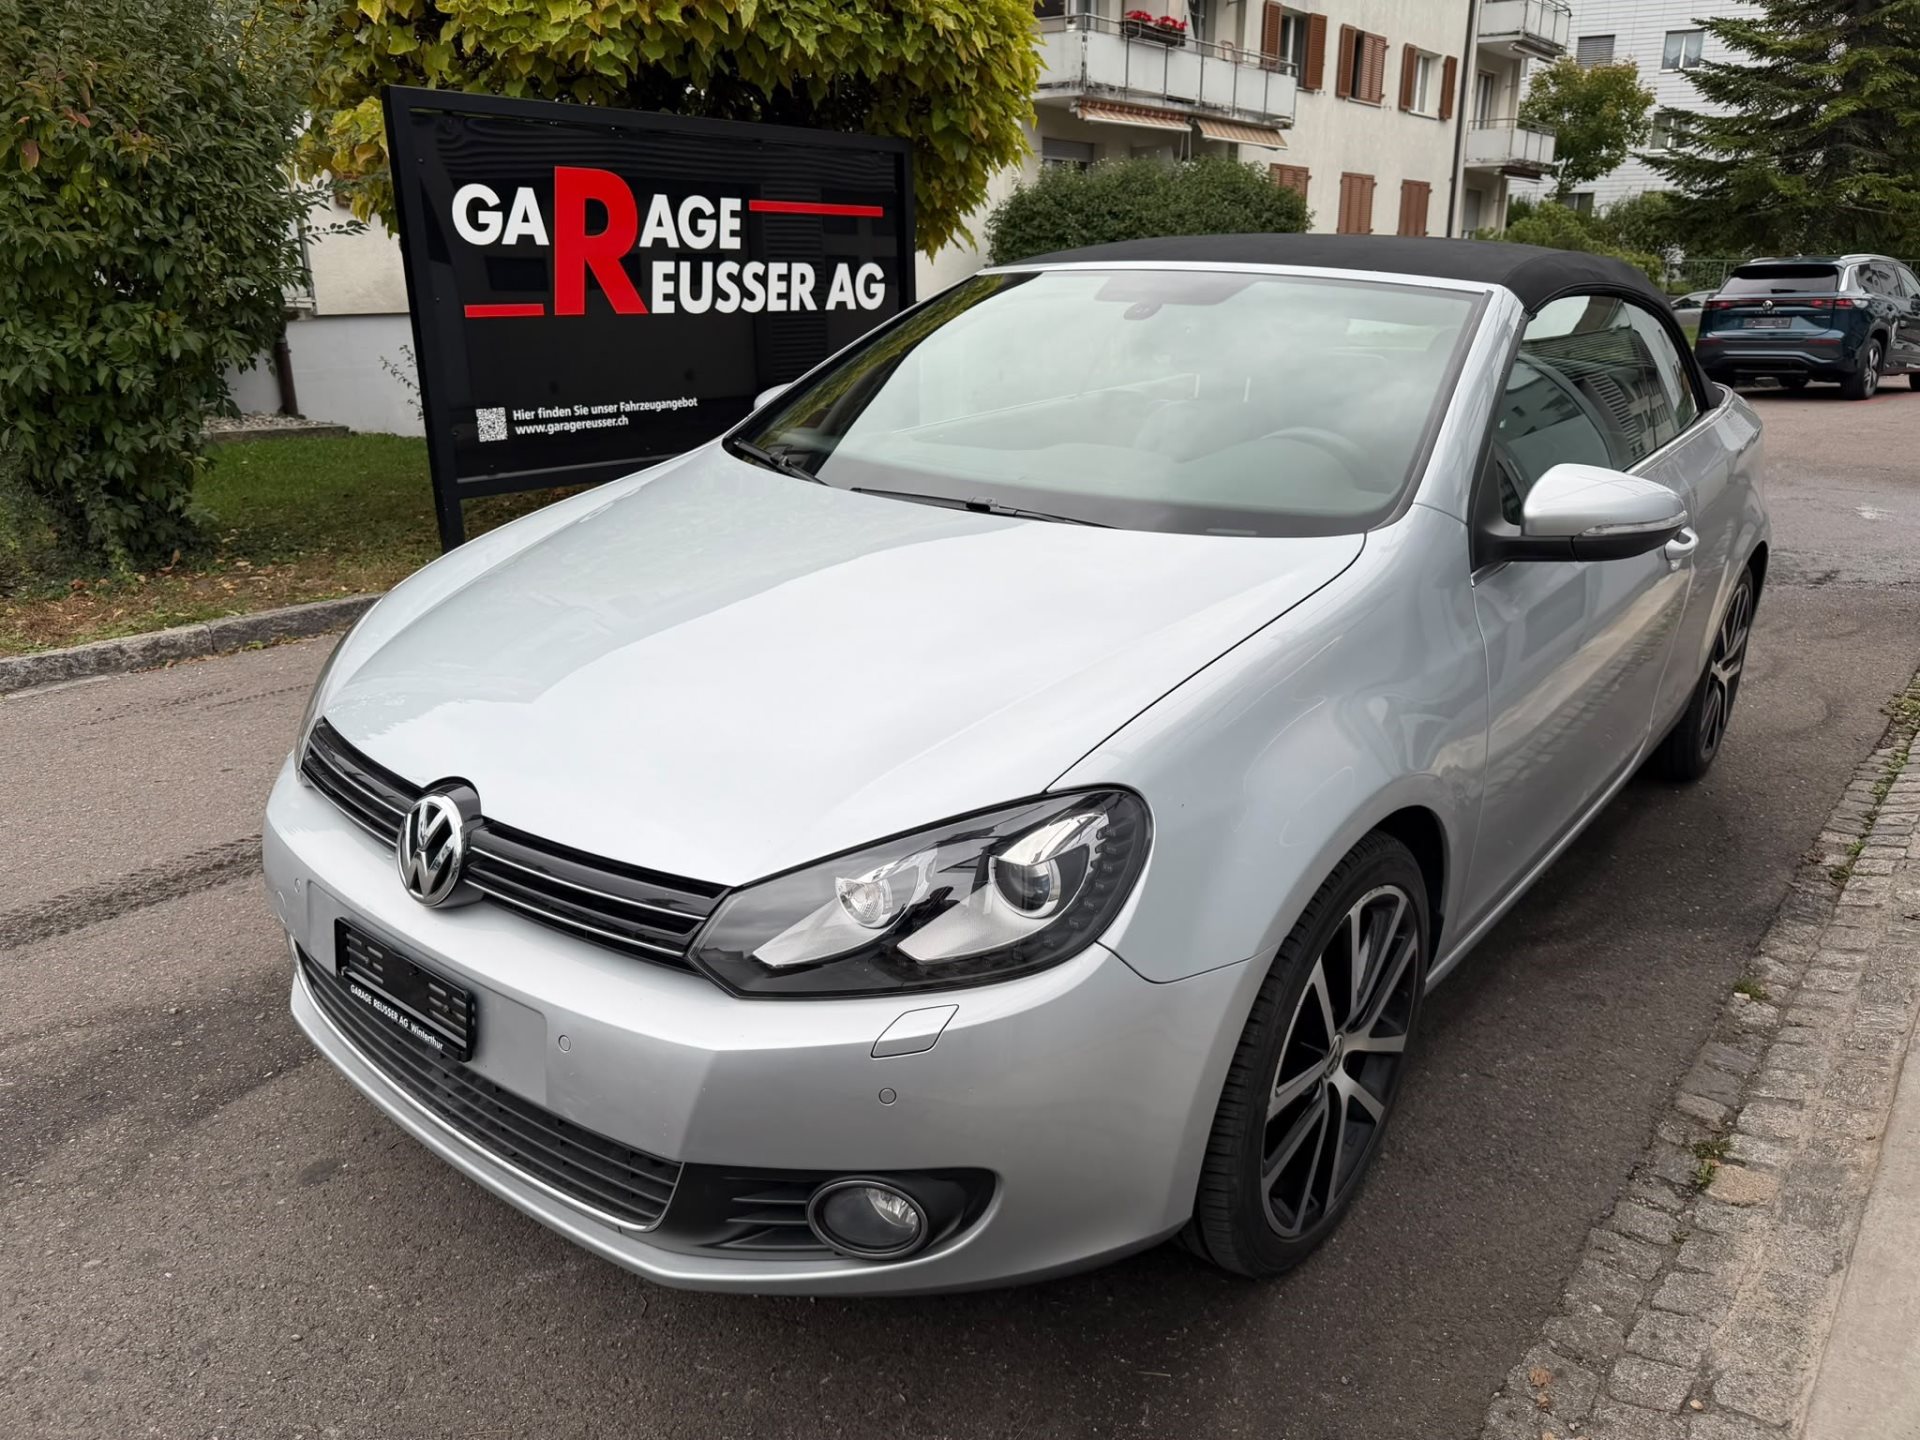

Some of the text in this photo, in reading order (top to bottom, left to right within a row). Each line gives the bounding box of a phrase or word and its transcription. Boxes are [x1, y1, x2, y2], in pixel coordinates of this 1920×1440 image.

[451, 165, 742, 316] GARAGE
[825, 261, 886, 312] AG
[513, 397, 699, 421] Hier finden Sie unser Fahrzeugangebot
[515, 415, 629, 435] www.garagereusser.ch
[350, 984, 444, 1050] GARAGE REUSSER AG Winterthur
